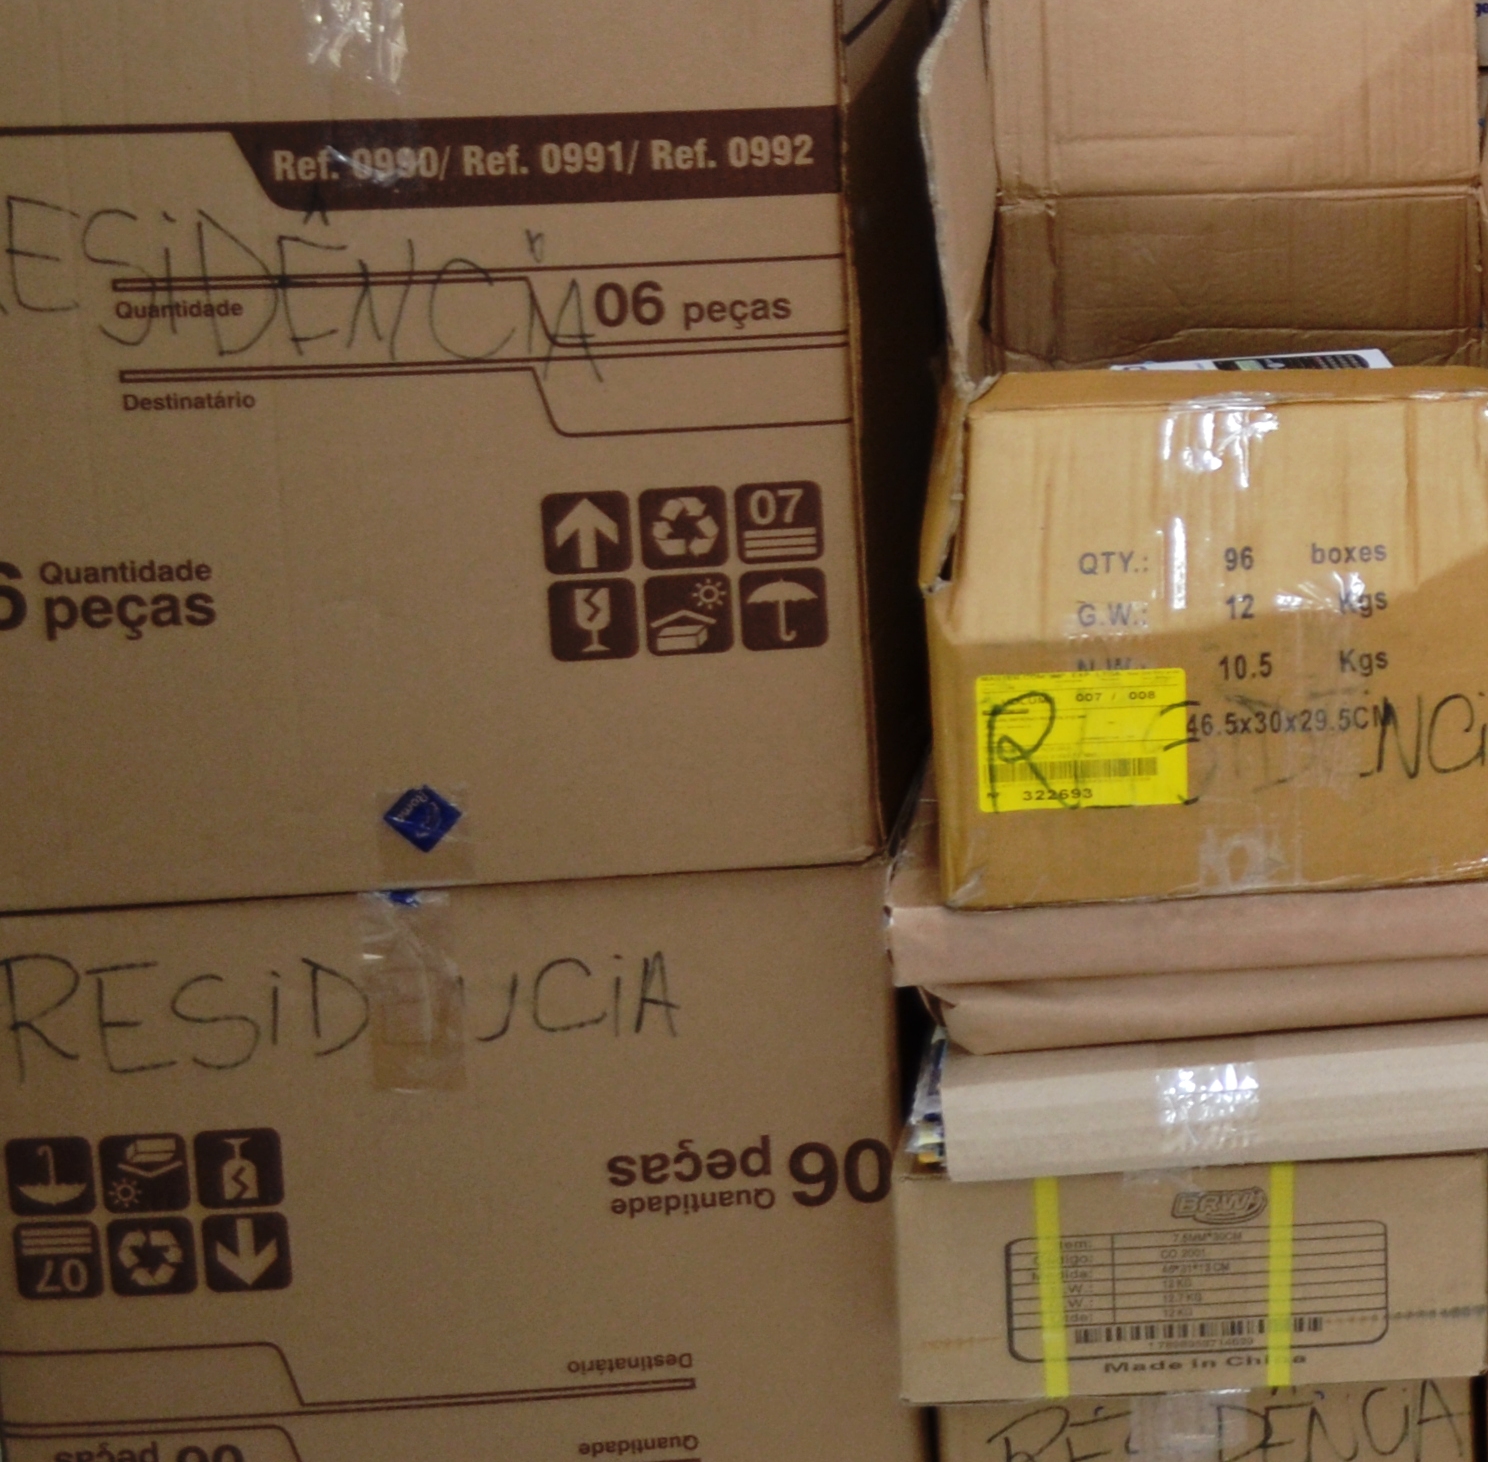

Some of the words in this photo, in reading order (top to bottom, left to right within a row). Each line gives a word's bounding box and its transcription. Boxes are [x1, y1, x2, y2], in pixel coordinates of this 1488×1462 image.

[273, 147, 340, 181] Ref.
[463, 144, 529, 178] Ref.
[541, 140, 640, 174] 0991/
[651, 137, 717, 171] Ref.
[728, 133, 815, 169] 0992
[115, 299, 244, 322] Quantidade
[595, 279, 665, 329] 06
[683, 292, 793, 333] peças
[122, 391, 257, 413] Destinatário
[749, 487, 805, 528] 07
[1223, 547, 1255, 572] 96
[1311, 541, 1388, 566] boxes
[38, 559, 213, 587] Quantidade
[44, 588, 218, 641] peças
[1225, 593, 1255, 620] 12
[1338, 589, 1389, 619] Kgs
[1219, 651, 1273, 682] 10.5
[1338, 648, 1389, 678] Kgs
[1075, 691, 1102, 703] 007
[1128, 690, 1157, 701] 008
[1023, 787, 1094, 802] 322693
[607, 1135, 773, 1186] peças
[788, 1137, 893, 1208] 06
[610, 1186, 776, 1218] Quantidade
[1173, 1188, 1256, 1221] BRW
[35, 1258, 89, 1294] 07
[567, 1352, 693, 1376] Destinatário
[1104, 1359, 1182, 1374] Made
[1191, 1354, 1217, 1369] in
[579, 1433, 700, 1458] Quantidade
